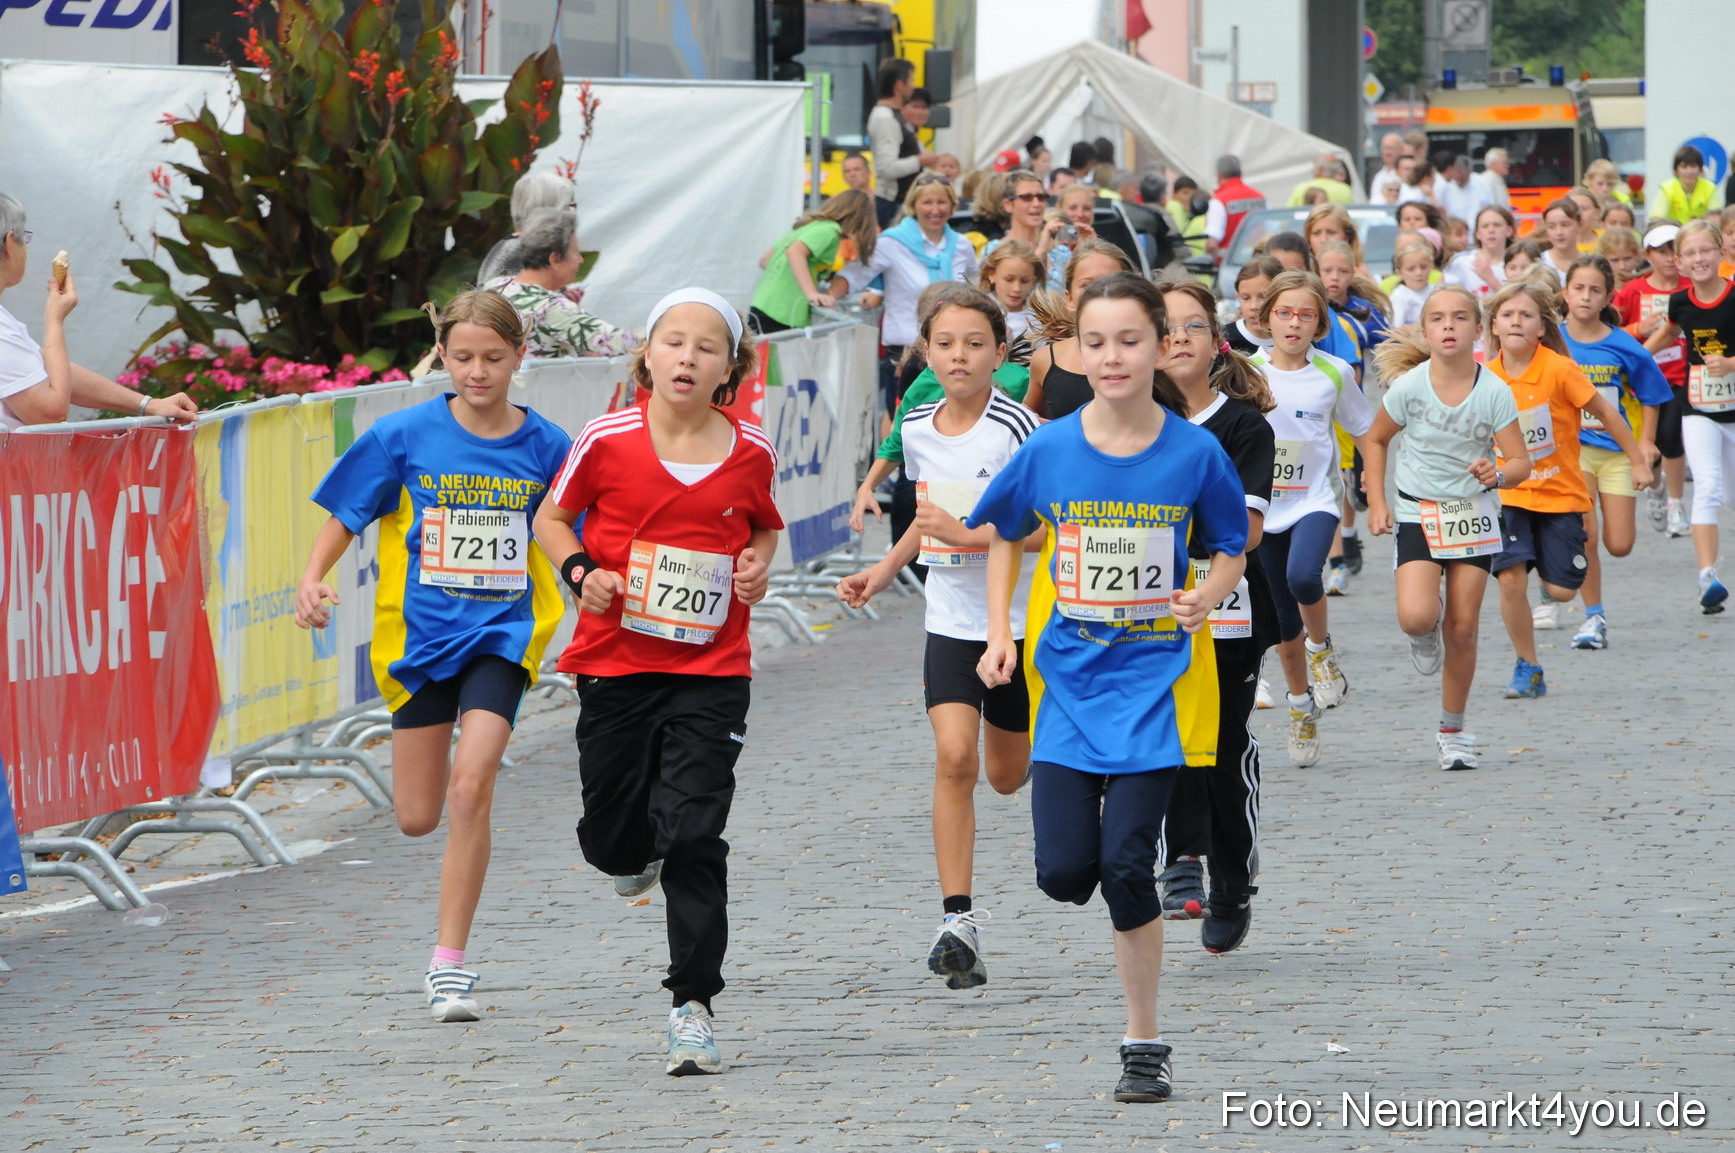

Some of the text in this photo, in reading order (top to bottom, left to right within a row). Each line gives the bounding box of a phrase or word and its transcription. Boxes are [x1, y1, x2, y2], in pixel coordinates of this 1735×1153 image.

[418, 474, 437, 489] 10.
[437, 490, 529, 510] STADTLAUF
[1441, 501, 1474, 515] Sophie
[449, 508, 510, 527] Fabienne
[1445, 516, 1493, 538] 7059
[451, 536, 517, 561] 7213
[1085, 536, 1136, 555] Amelie
[484, 575, 525, 583] PFLEIDERER
[1088, 565, 1162, 591] 7212
[656, 582, 723, 617] 7207
[1126, 603, 1170, 614] PFLEIDERER
[1211, 625, 1250, 633] PFLEIDERER
